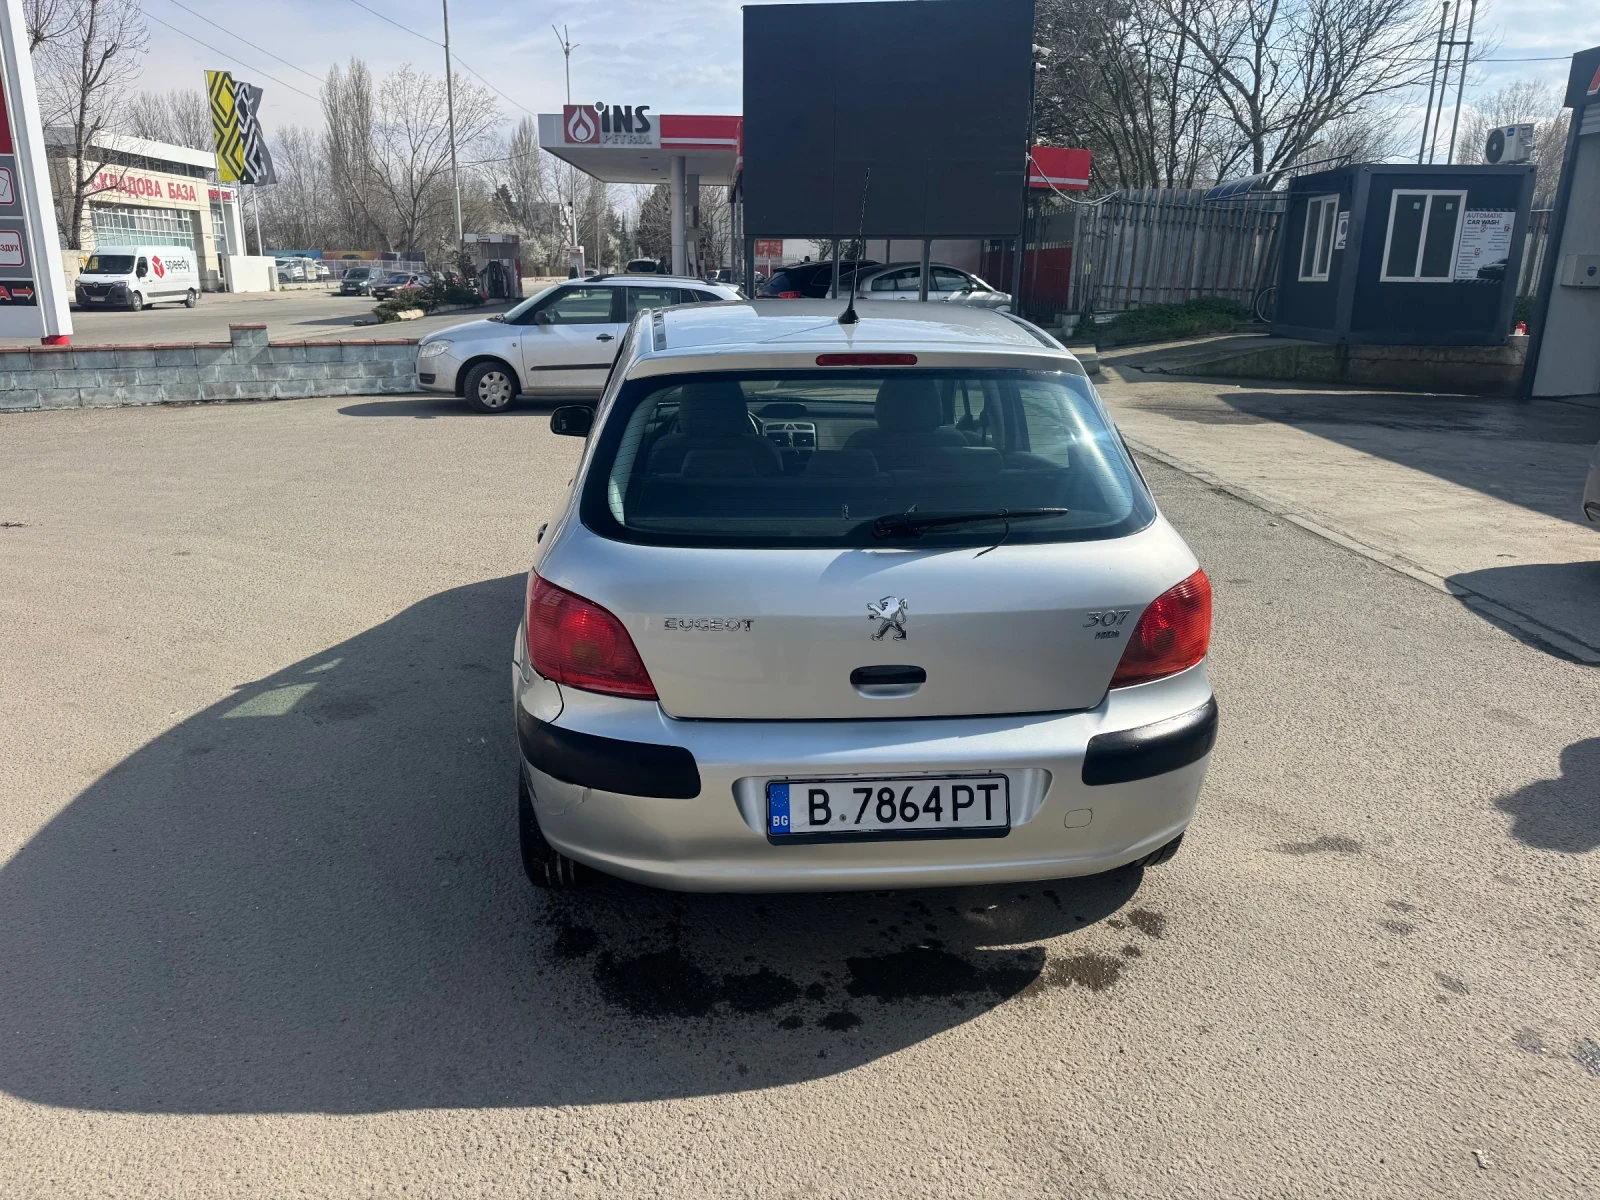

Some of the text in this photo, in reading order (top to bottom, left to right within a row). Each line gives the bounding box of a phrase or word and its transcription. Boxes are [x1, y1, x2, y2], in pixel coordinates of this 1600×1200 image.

[602, 134, 652, 145] PETROL
[167, 182, 197, 202] БАЗА
[164, 256, 191, 273] speedy
[663, 617, 755, 633] EUGEOT
[1082, 609, 1131, 628] 307
[807, 788, 832, 826] B
[772, 815, 789, 827] BG
